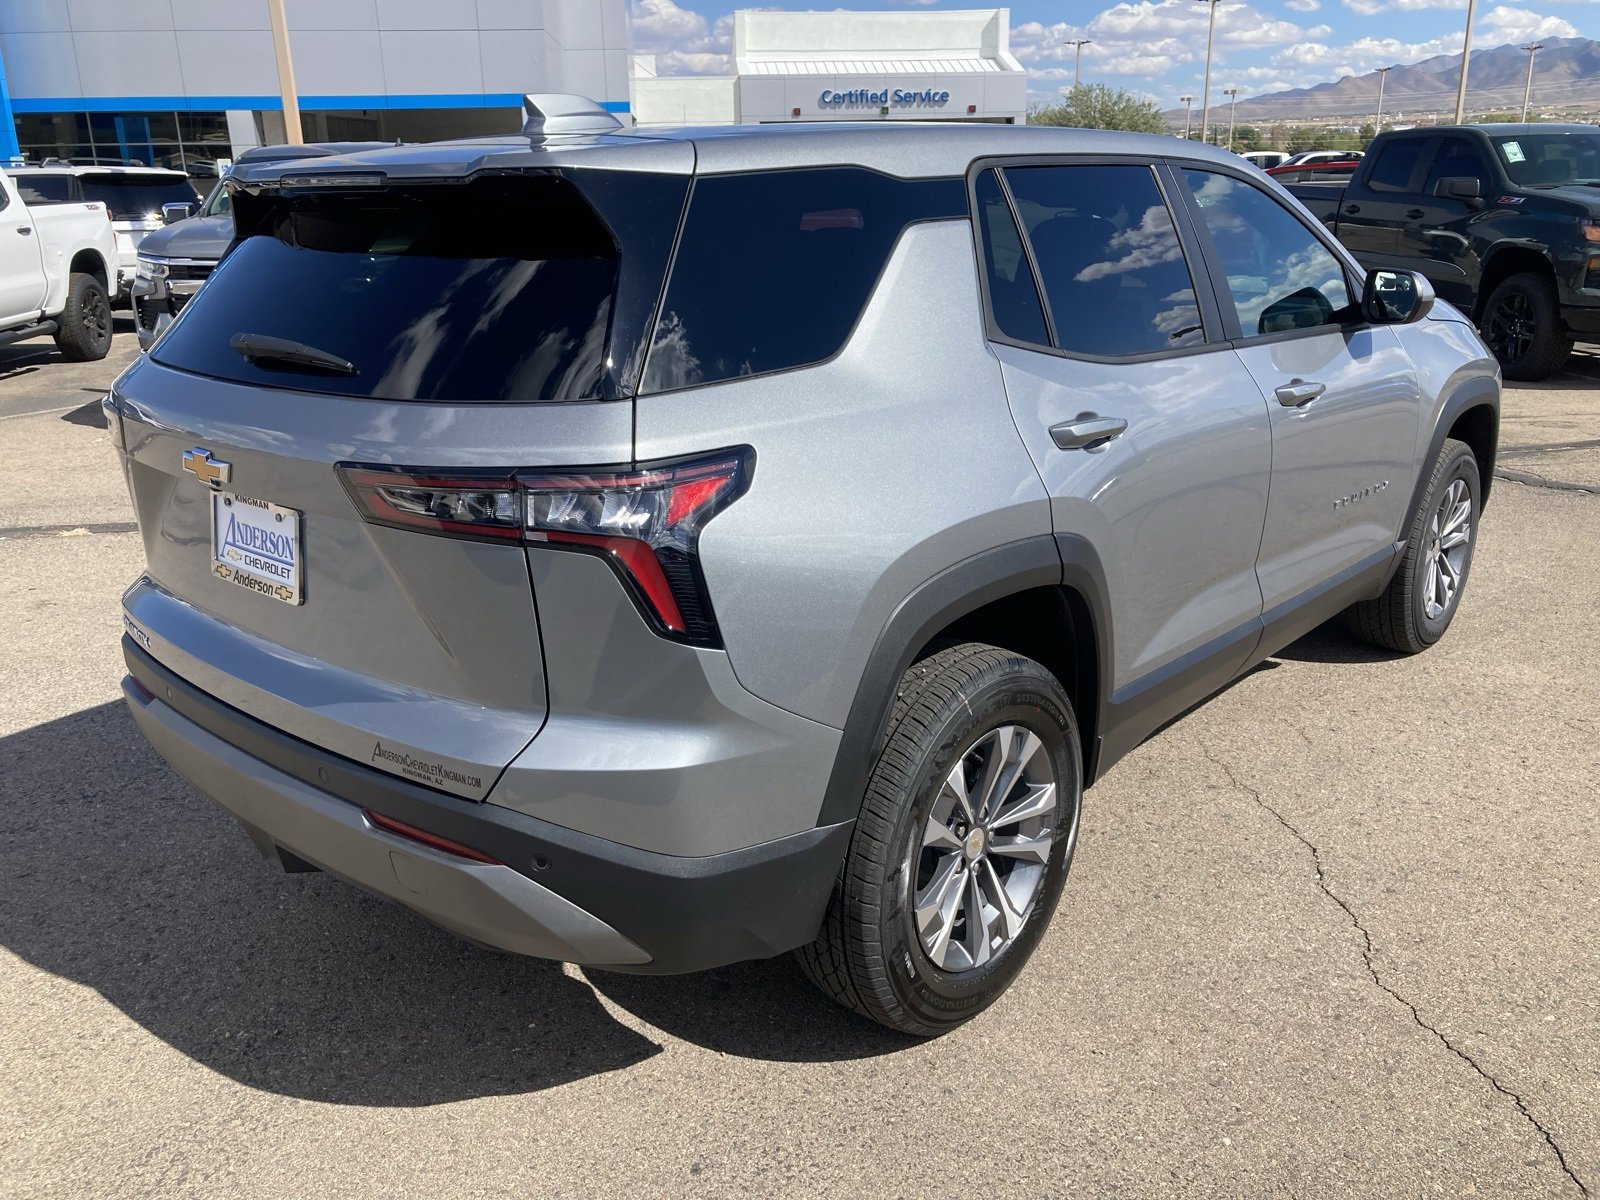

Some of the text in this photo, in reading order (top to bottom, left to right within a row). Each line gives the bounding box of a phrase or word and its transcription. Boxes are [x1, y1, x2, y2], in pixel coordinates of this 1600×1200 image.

[821, 88, 950, 104] Certified Service
[234, 493, 270, 510] KINGMAN
[220, 512, 295, 561] ANDERSON
[244, 554, 292, 580] CHEVROLET
[233, 570, 274, 596] Anderson
[402, 767, 444, 786] KINGMAN, AZ
